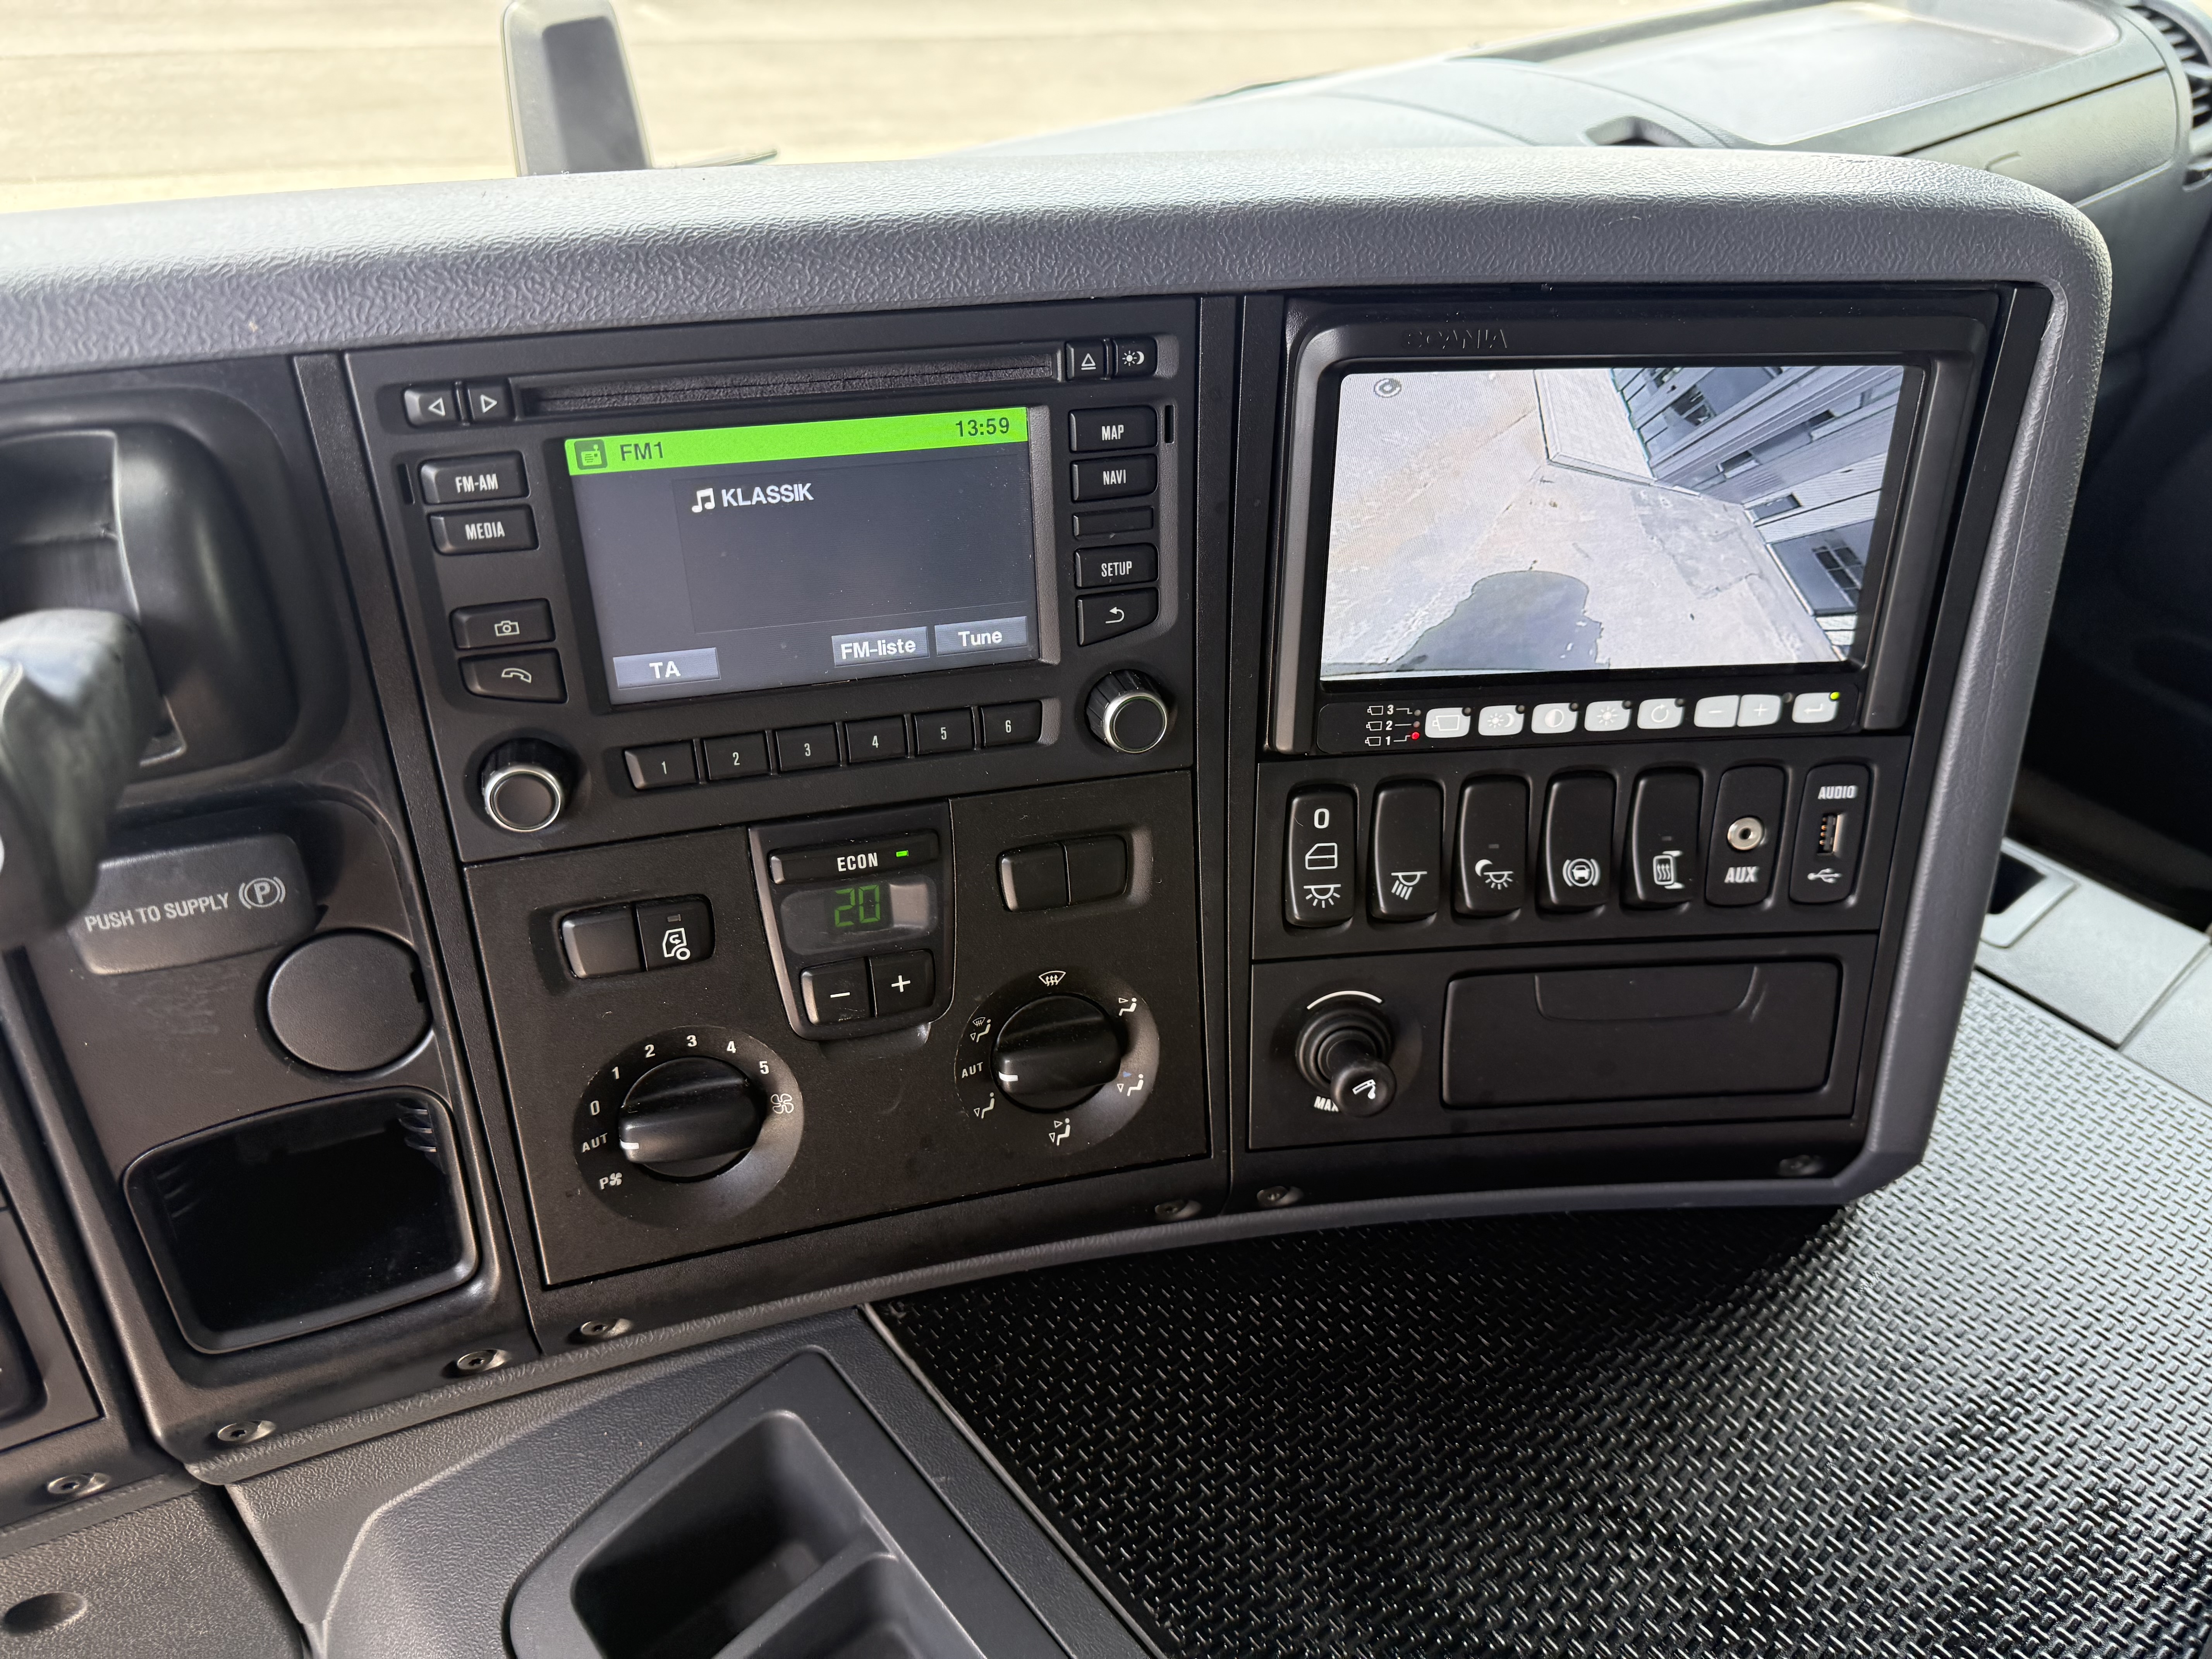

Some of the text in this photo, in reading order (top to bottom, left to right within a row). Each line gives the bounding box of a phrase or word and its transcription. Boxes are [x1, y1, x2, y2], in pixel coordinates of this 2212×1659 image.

[955, 417, 1010, 437] 13:59
[1101, 424, 1125, 441] MAP
[619, 441, 663, 462] FM1
[455, 473, 499, 493] FM-AM
[1103, 469, 1127, 486] NAVI
[721, 483, 814, 507] KLASSIK
[465, 521, 505, 540] MEDIA
[1101, 560, 1132, 577] SETUP
[957, 630, 1003, 647] Tune
[840, 638, 917, 660] FM-liste
[649, 660, 682, 679] TA
[1386, 704, 1394, 715] 3
[940, 726, 947, 740] 5
[1005, 720, 1012, 733] 6
[1385, 720, 1393, 731] 2
[872, 735, 879, 749] 4
[1385, 735, 1391, 746] 1
[804, 743, 811, 757] 3
[732, 752, 740, 766] 2
[661, 761, 667, 775] 1
[1818, 785, 1857, 800] AUDIO
[836, 852, 878, 872] ECON
[1724, 866, 1757, 883] AUX
[84, 910, 135, 933] PUSH
[135, 905, 161, 924] TO
[163, 892, 229, 918] SUPPLY
[834, 884, 881, 927] 20
[686, 1034, 697, 1047] 3
[726, 1041, 737, 1054] 4
[644, 1044, 656, 1058] 2
[611, 1066, 620, 1080] 1
[759, 1060, 769, 1075] 5
[961, 1061, 984, 1079] AUT
[590, 1100, 600, 1116] 0
[582, 1132, 608, 1153] AUT
